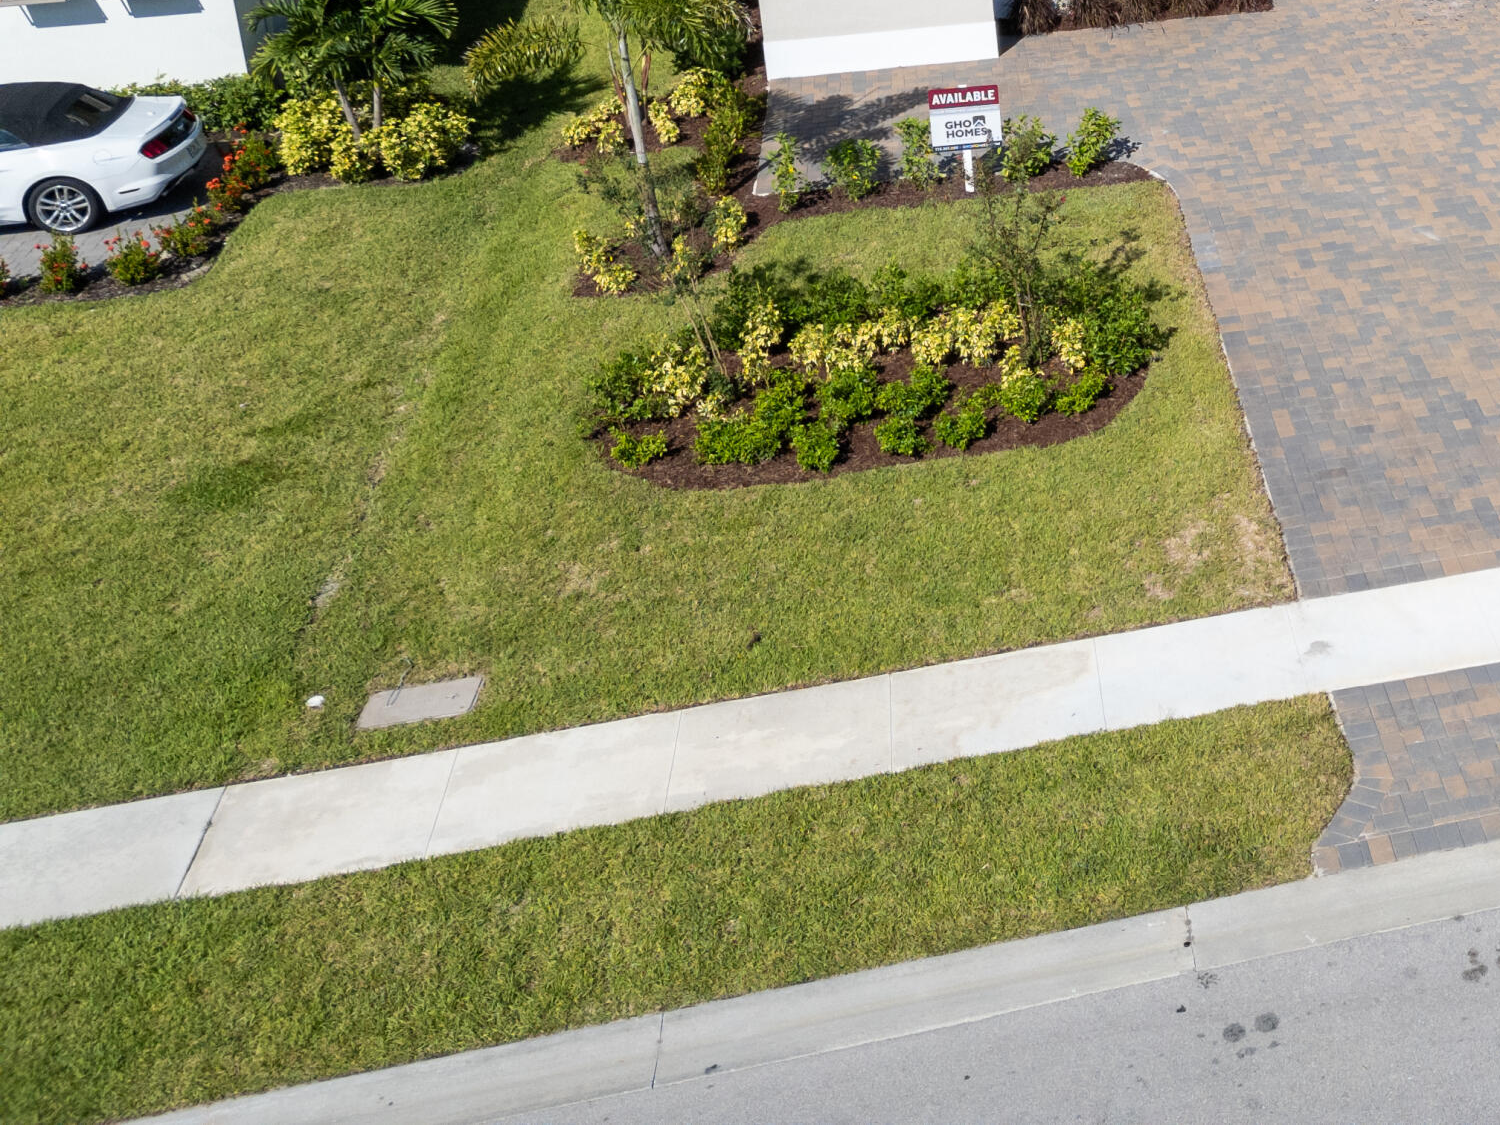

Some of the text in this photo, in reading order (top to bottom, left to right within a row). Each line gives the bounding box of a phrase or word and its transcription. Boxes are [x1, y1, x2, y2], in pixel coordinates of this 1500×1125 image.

[932, 89, 996, 105] AVAILABLE
[945, 119, 972, 130] GHO
[946, 128, 987, 139] HOMES
